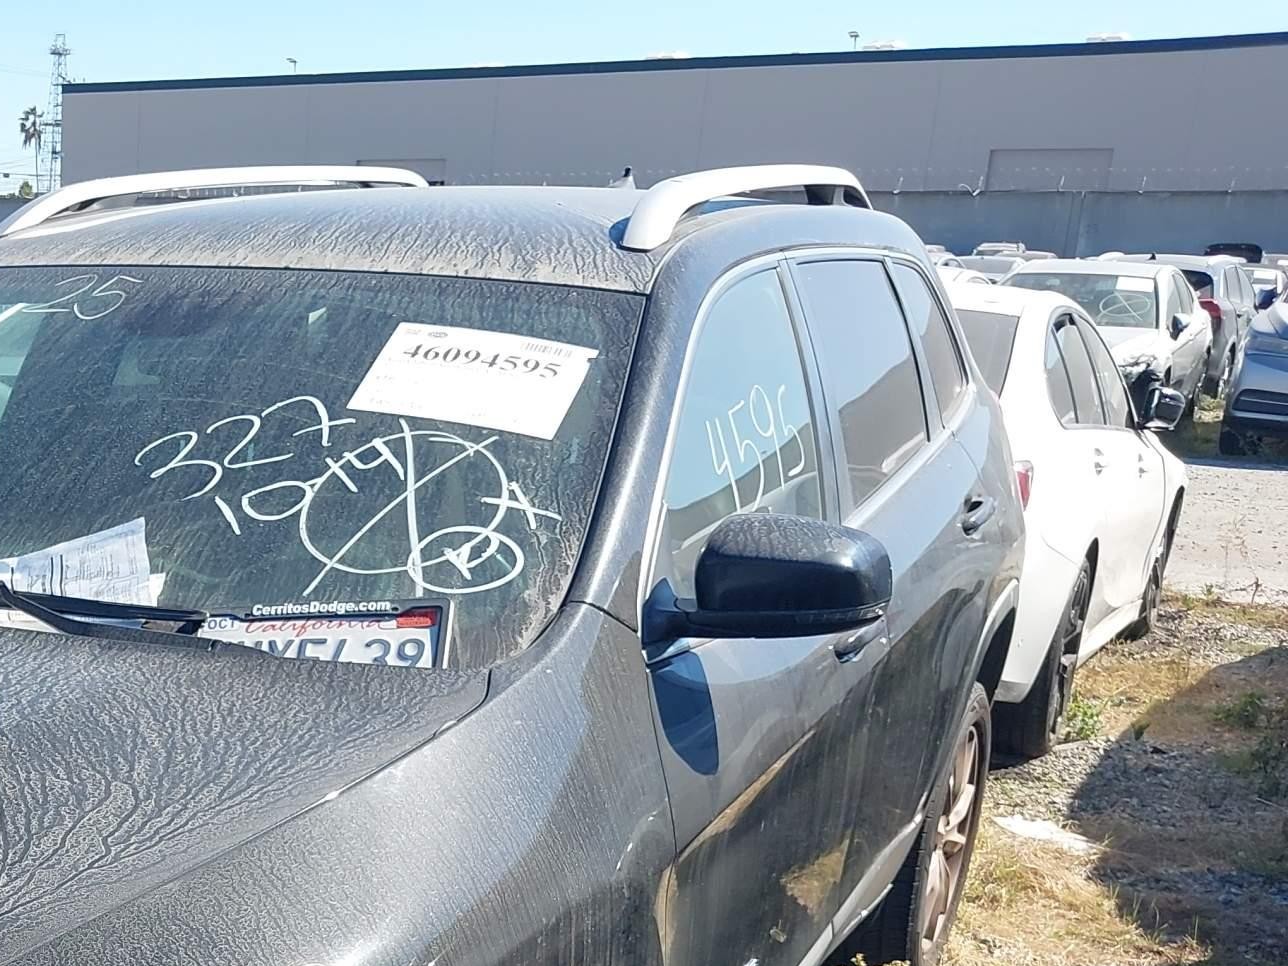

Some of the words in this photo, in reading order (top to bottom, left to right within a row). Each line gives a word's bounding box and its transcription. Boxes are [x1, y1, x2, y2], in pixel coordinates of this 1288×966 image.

[20, 273, 145, 320] 25
[402, 343, 562, 378] 46094595
[134, 395, 357, 502] 327
[704, 384, 805, 513] 4595
[252, 601, 391, 617] CerritosDodge.com
